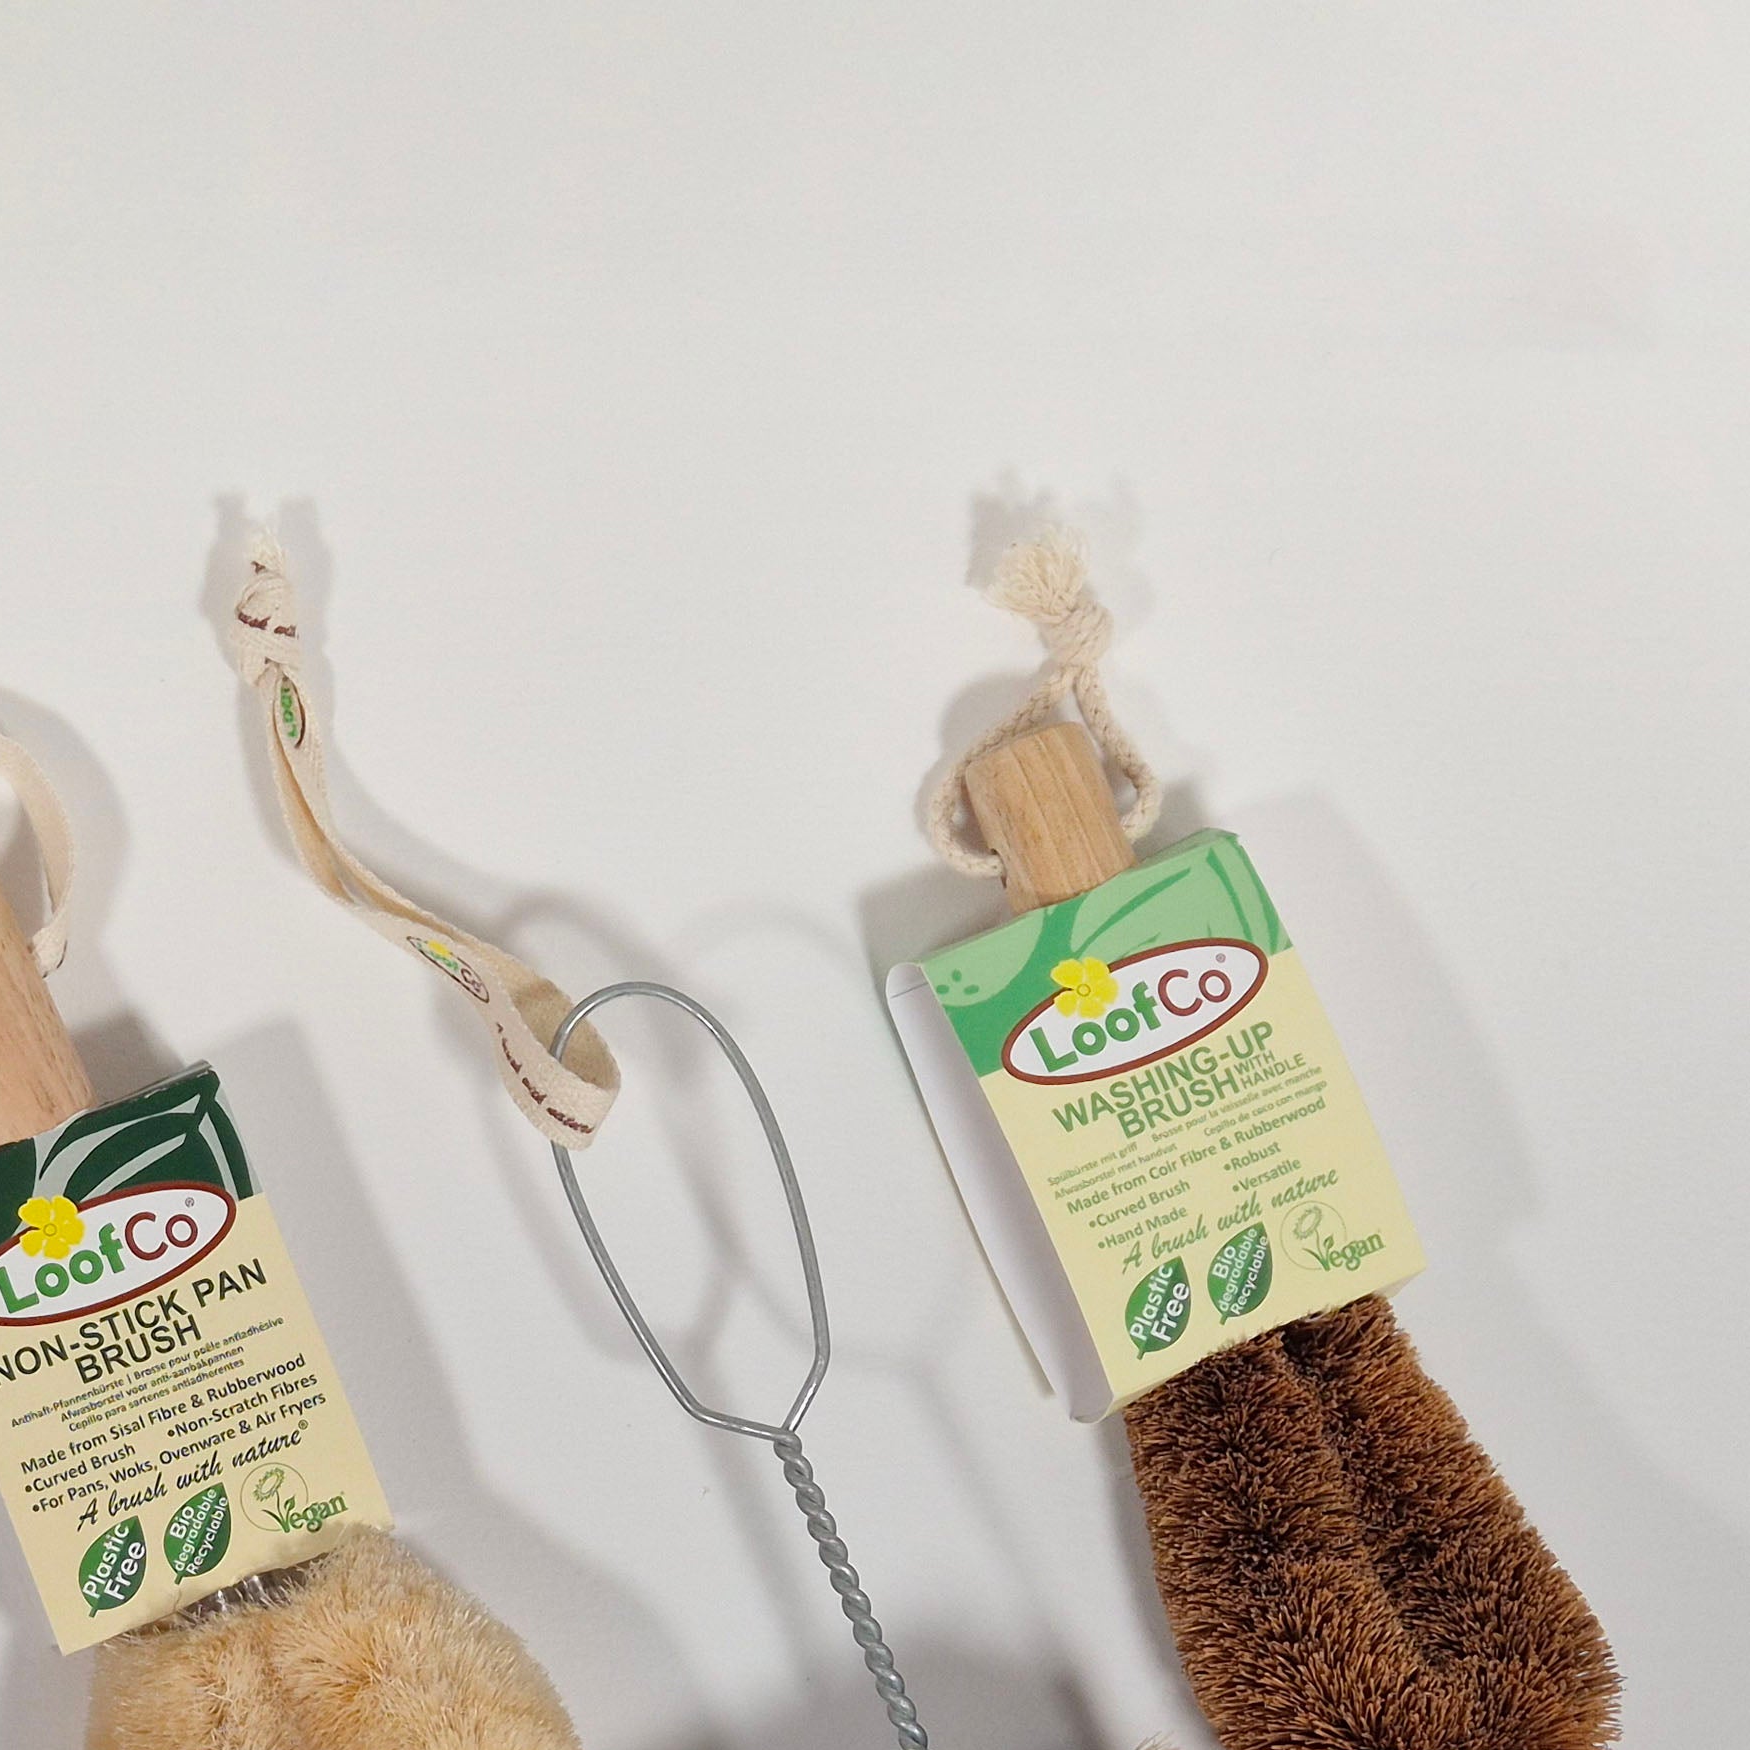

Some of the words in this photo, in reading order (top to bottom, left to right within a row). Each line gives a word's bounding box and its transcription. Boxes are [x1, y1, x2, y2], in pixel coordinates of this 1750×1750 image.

[1052, 1021, 1272, 1132] WASHING-UP
[1116, 1068, 1239, 1140] BRUSH
[1233, 1049, 1275, 1075] WITH
[1240, 1053, 1306, 1092] HANDLE
[1066, 1188, 1110, 1214] Made
[1110, 1174, 1147, 1196] from
[1148, 1160, 1177, 1180] Coir
[1179, 1141, 1216, 1167] Fibre
[1215, 1132, 1234, 1152] &
[1233, 1096, 1328, 1143] Rubberwood
[191, 1258, 266, 1308] PAN
[1212, 1246, 1236, 1279] Bio
[1218, 1228, 1257, 1312] degradable
[1230, 1236, 1271, 1315] Recyclable
[1303, 1233, 1384, 1272] Vegan
[1130, 1263, 1173, 1341] Plastic
[1150, 1282, 1192, 1342] Free
[74, 1314, 201, 1383] BRUSH
[20, 1449, 67, 1474] Made
[68, 1433, 108, 1456] from
[109, 1415, 146, 1440] Sisal
[147, 1402, 187, 1425] Fibre
[187, 1392, 205, 1410] &
[206, 1353, 305, 1402] Rubberwood
[76, 1497, 99, 1532] A
[107, 1471, 168, 1517] brush
[176, 1449, 223, 1490] with
[262, 1495, 347, 1534] Vegan
[83, 1521, 129, 1599] Plastic
[103, 1541, 145, 1600] Free
